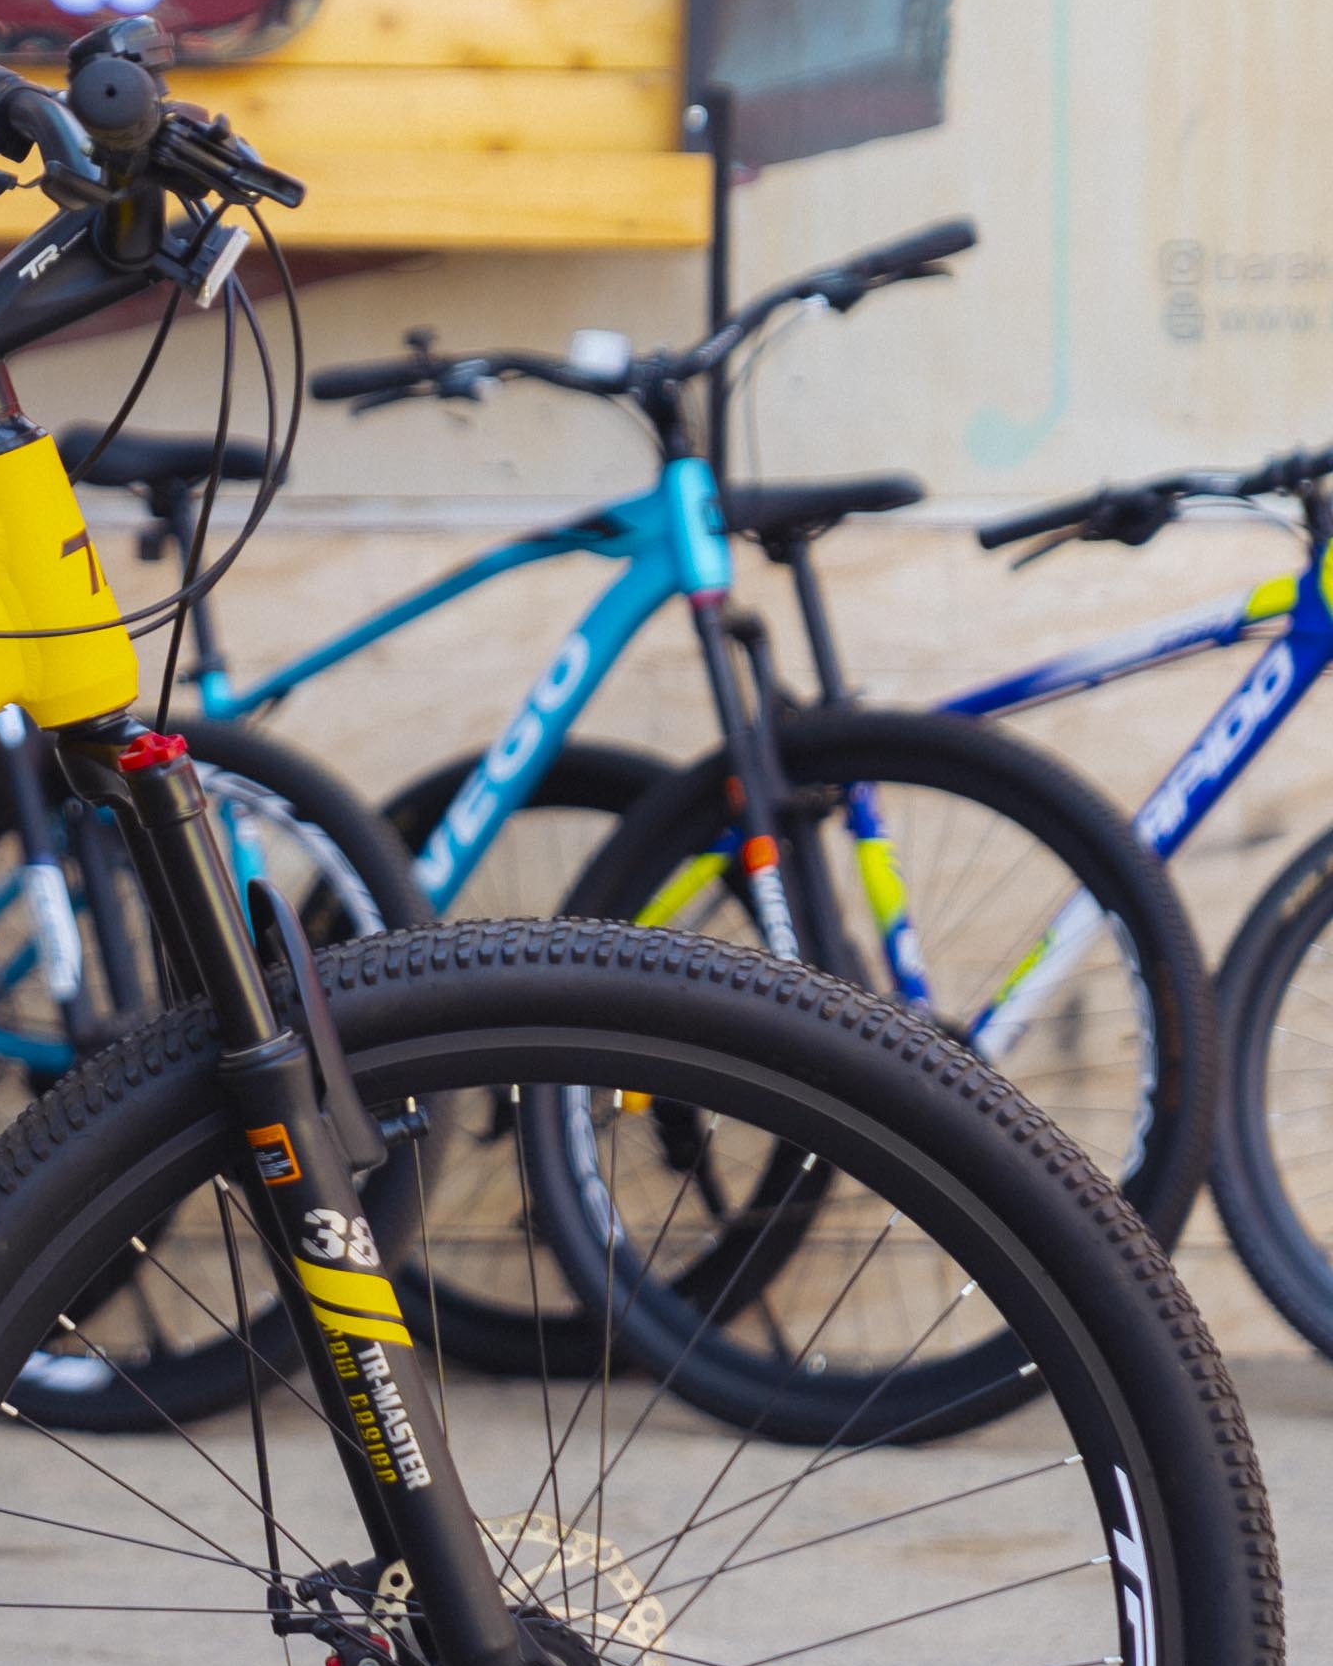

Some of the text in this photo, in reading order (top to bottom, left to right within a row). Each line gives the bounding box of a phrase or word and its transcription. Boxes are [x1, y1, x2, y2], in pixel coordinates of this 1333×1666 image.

[18, 243, 61, 279] TR
[300, 1207, 381, 1269] 38
[357, 1341, 432, 1492] TR-MASTER
